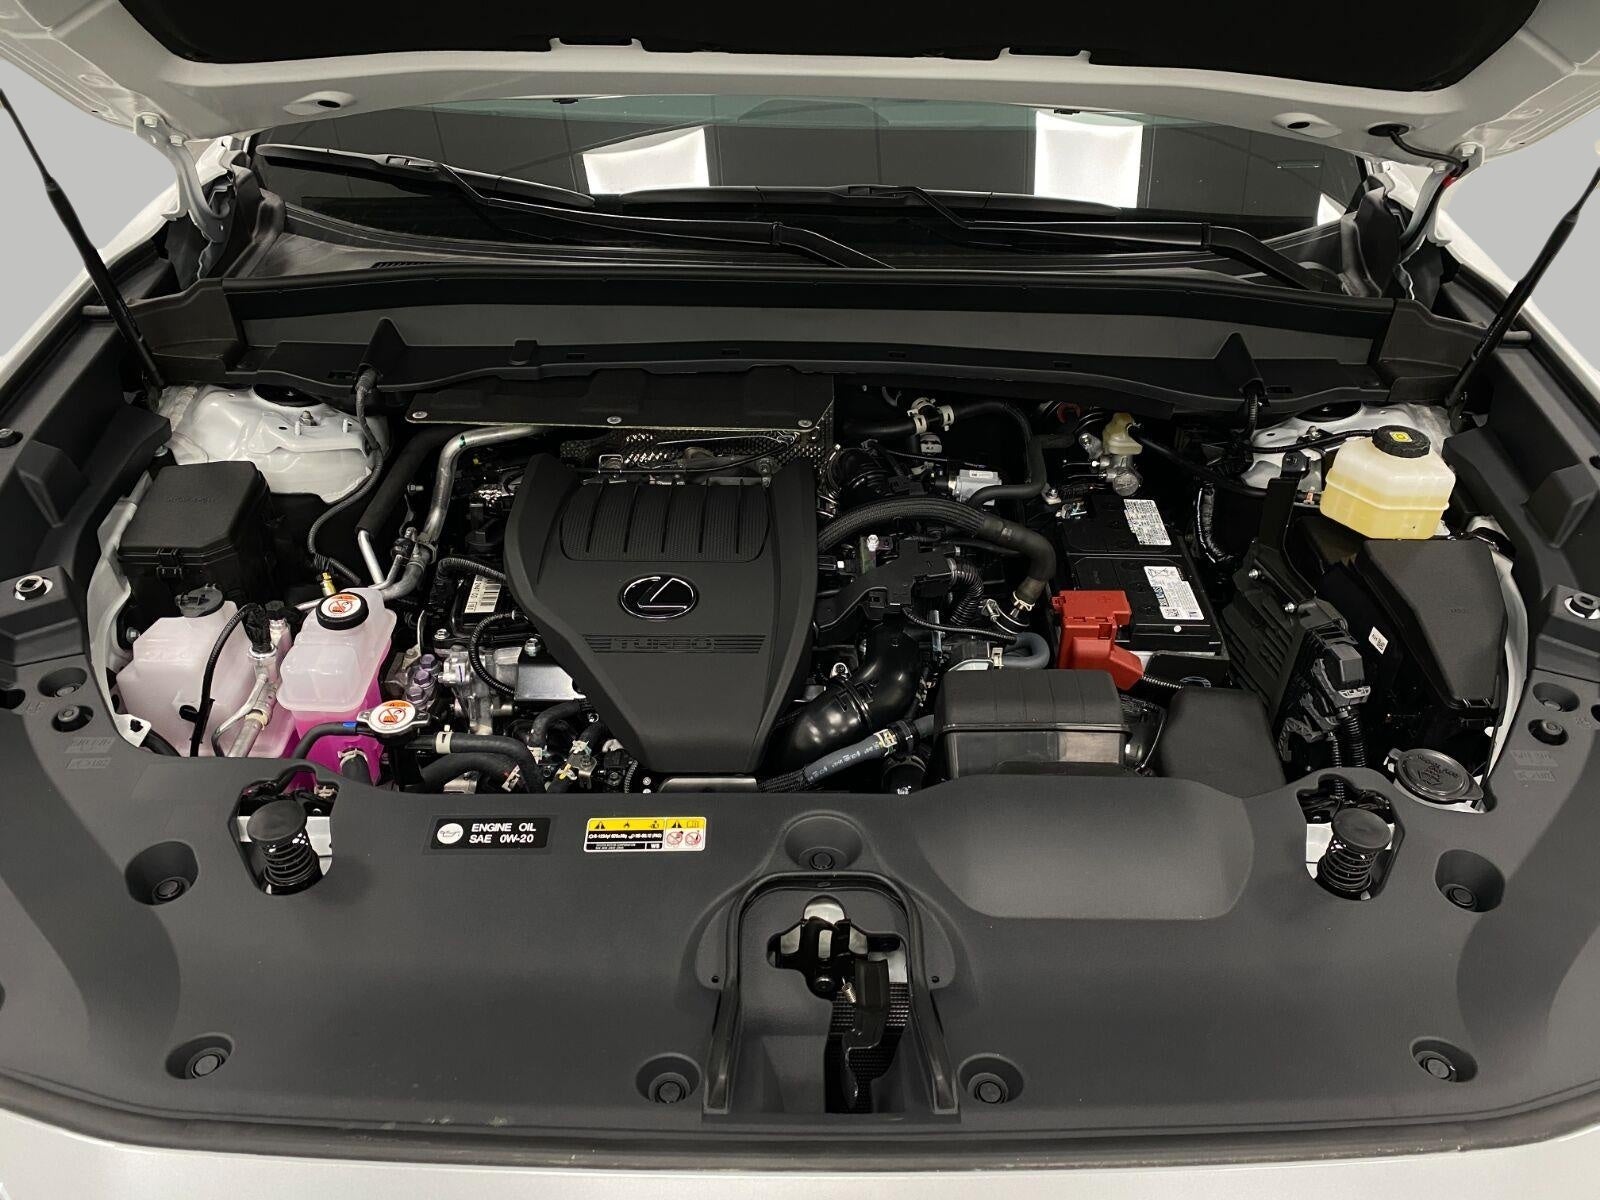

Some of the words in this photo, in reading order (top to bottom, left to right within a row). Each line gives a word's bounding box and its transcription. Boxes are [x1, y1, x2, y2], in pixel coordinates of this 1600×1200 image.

[613, 637, 714, 650] TURBO
[471, 823, 513, 832] ENGINE
[518, 823, 537, 832] OIL
[469, 834, 492, 843] SAE
[499, 834, 534, 843] 0W-20
